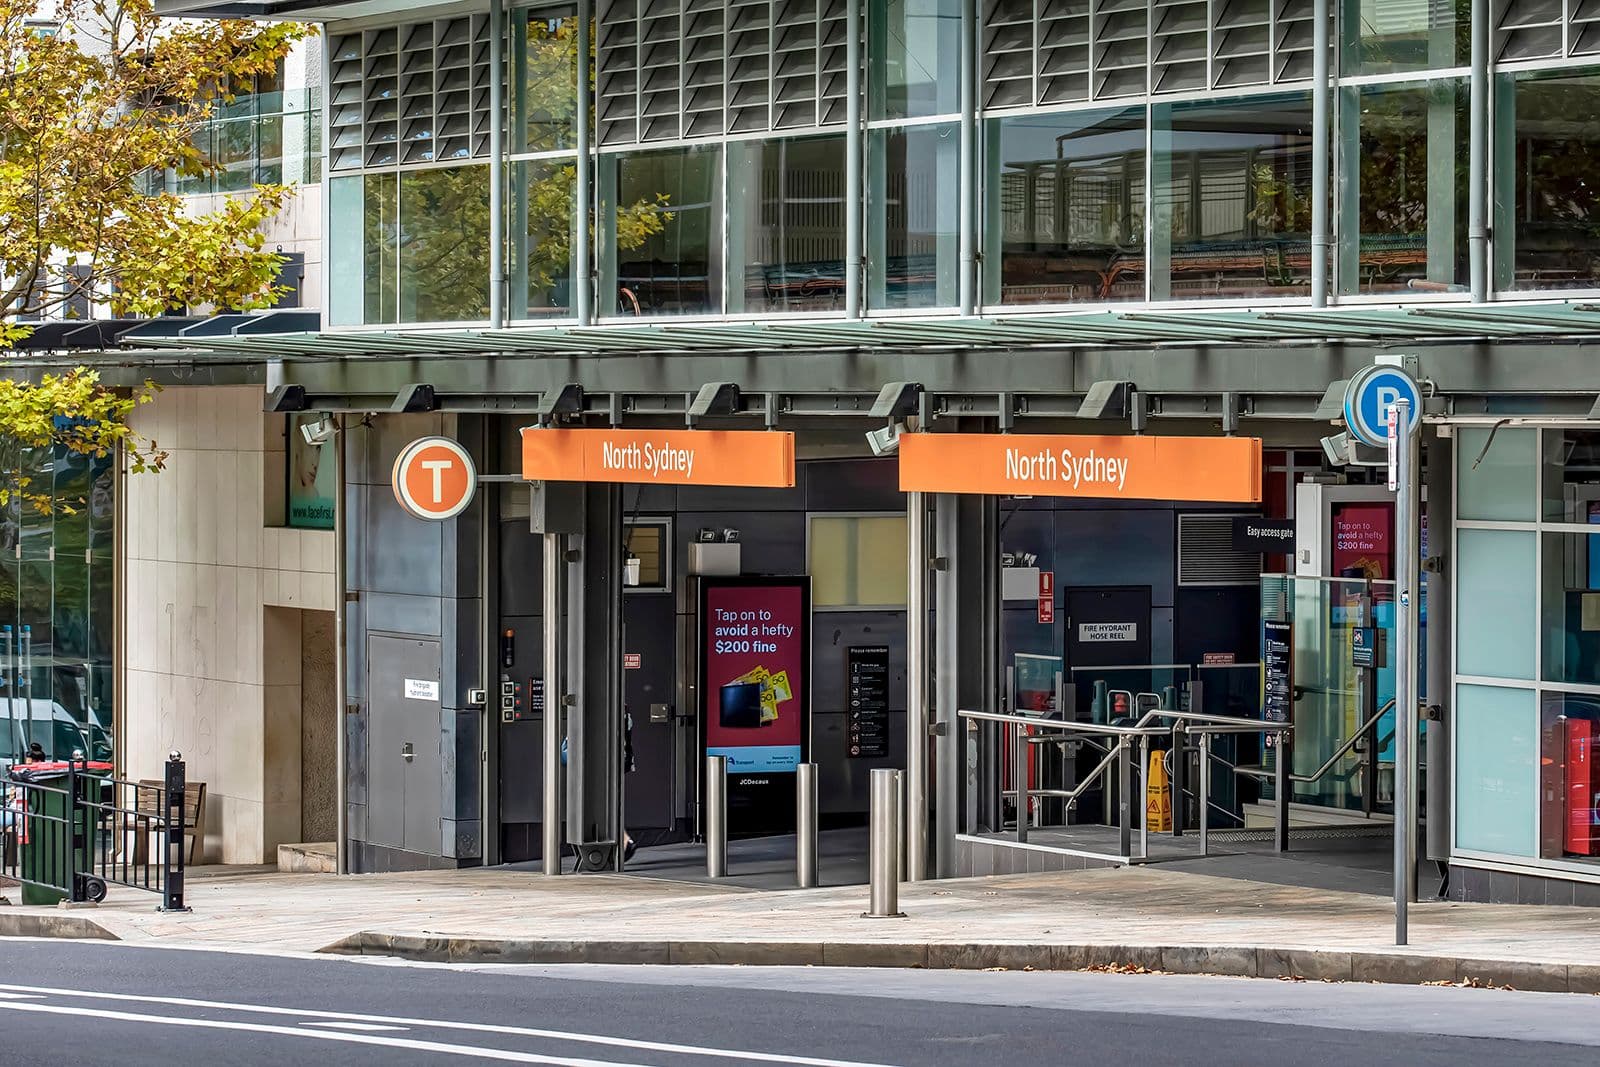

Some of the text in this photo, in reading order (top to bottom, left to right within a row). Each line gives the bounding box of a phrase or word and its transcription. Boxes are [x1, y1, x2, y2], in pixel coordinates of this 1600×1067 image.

[603, 441, 694, 479] North Sydney
[1006, 448, 1128, 492] North Sydney
[421, 460, 453, 504] T
[1247, 525, 1294, 540] Easy access gate
[1337, 521, 1351, 531] Tap
[1363, 522, 1371, 530] to
[1337, 531, 1358, 539] avoid
[1364, 531, 1384, 541] hefty
[1337, 541, 1374, 550] $200 fine
[715, 608, 772, 623] Tap on to
[715, 623, 793, 638] avoid a hefty
[1099, 624, 1131, 632] HYDRANT
[1109, 632, 1125, 640] REEL
[715, 640, 777, 654] $200 fine
